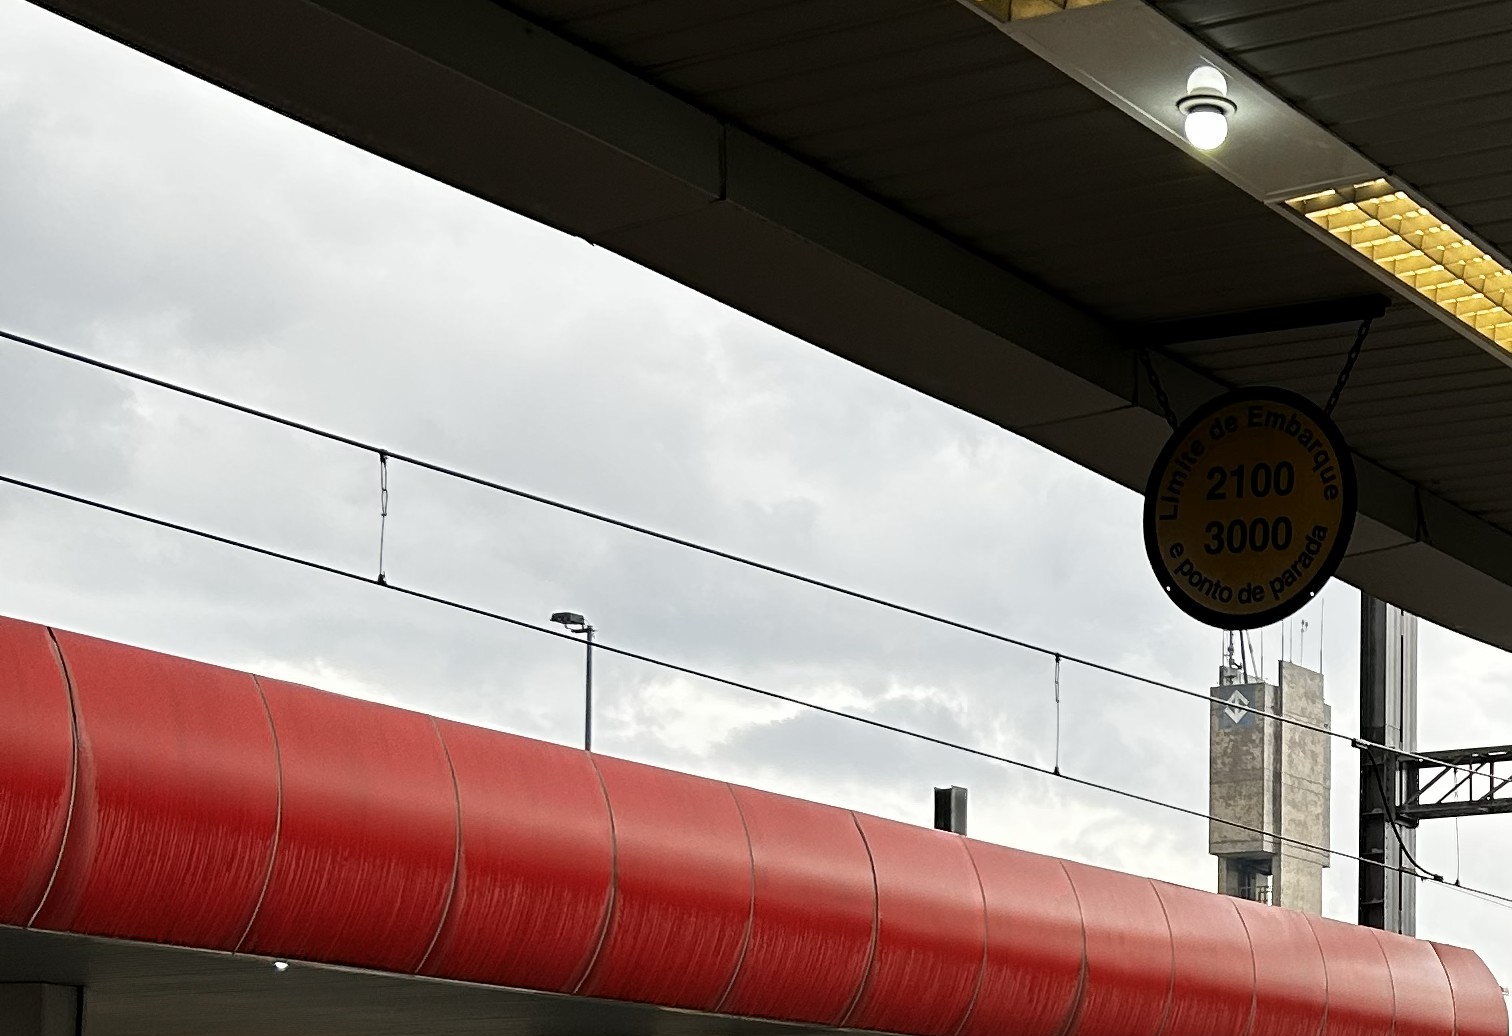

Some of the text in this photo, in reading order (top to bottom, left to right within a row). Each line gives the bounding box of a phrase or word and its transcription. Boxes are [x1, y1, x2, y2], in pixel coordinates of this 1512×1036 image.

[1159, 405, 1339, 521] Limite de Embarque
[1206, 461, 1294, 501] 2100
[1169, 525, 1329, 604] e ponto de parada
[1203, 516, 1293, 555] 3000
